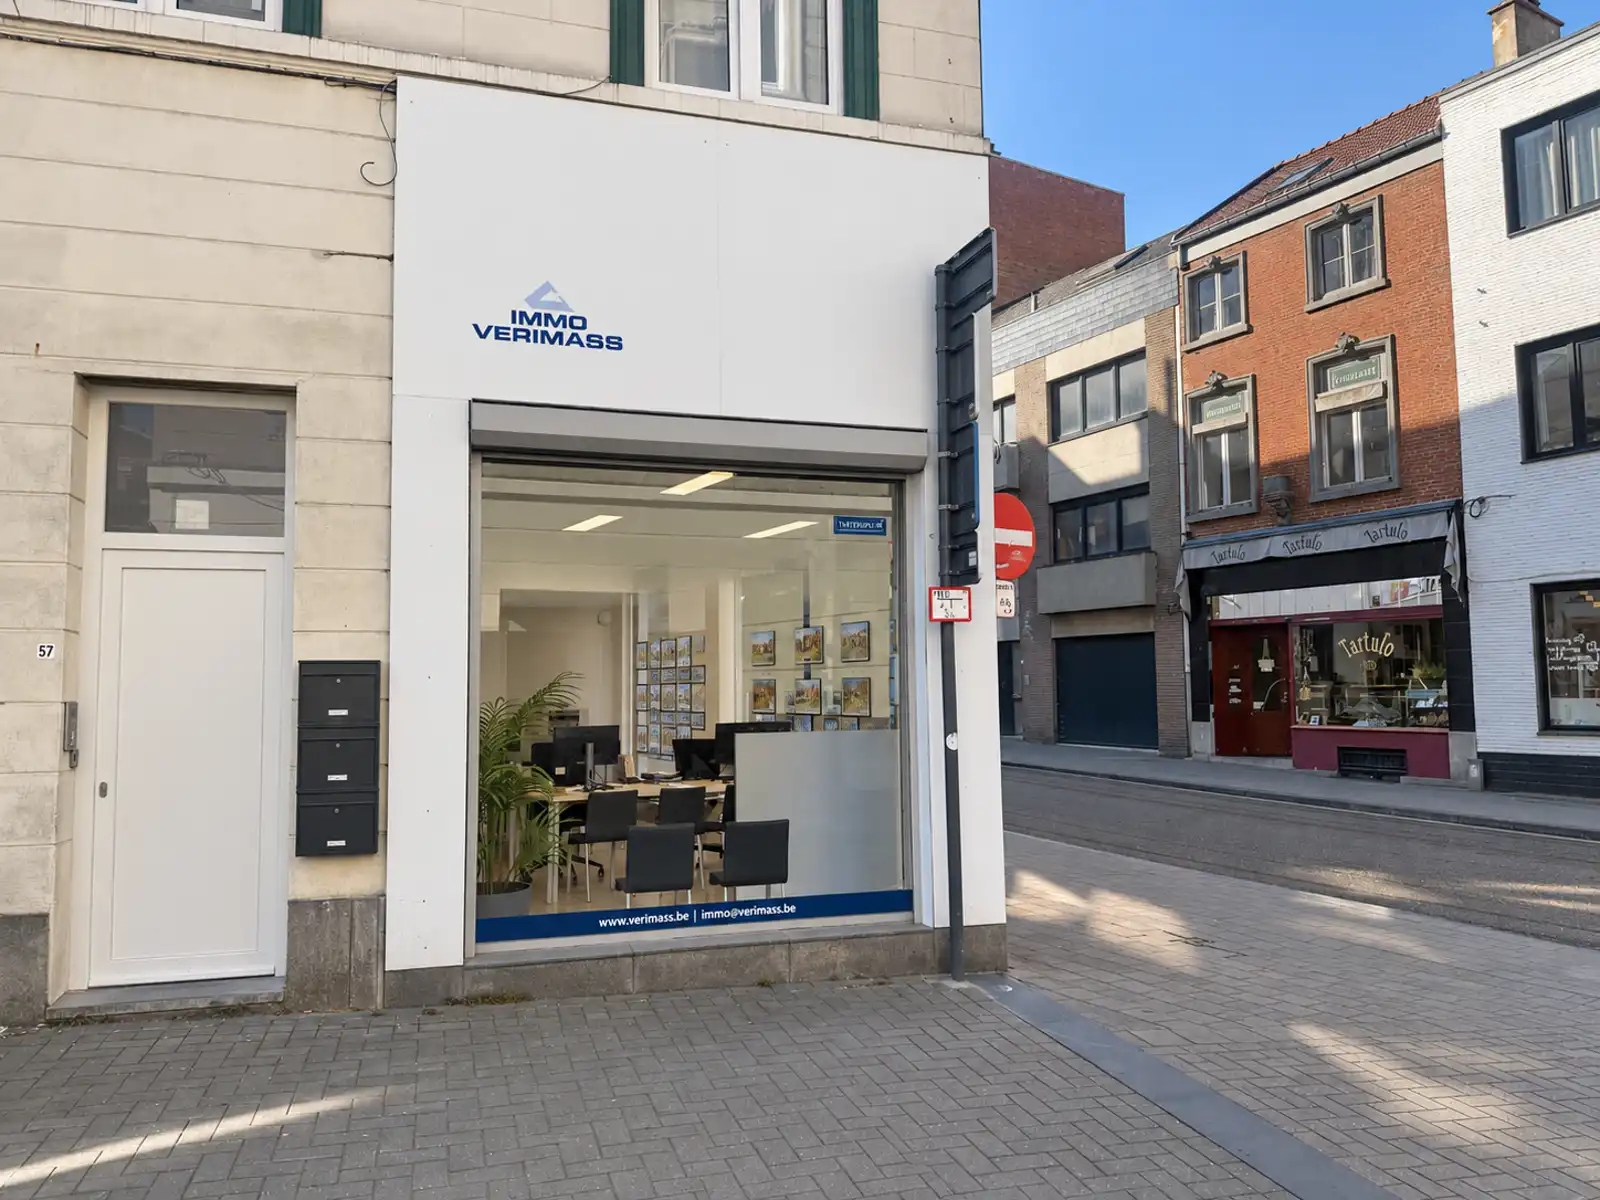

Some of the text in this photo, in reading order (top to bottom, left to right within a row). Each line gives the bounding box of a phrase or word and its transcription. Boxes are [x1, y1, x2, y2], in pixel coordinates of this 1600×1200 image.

[511, 309, 588, 331] IMMO
[472, 323, 623, 351] VERIMASS
[38, 644, 54, 658] 57
[598, 903, 797, 928] www.verimass.be immo@verimass.be
